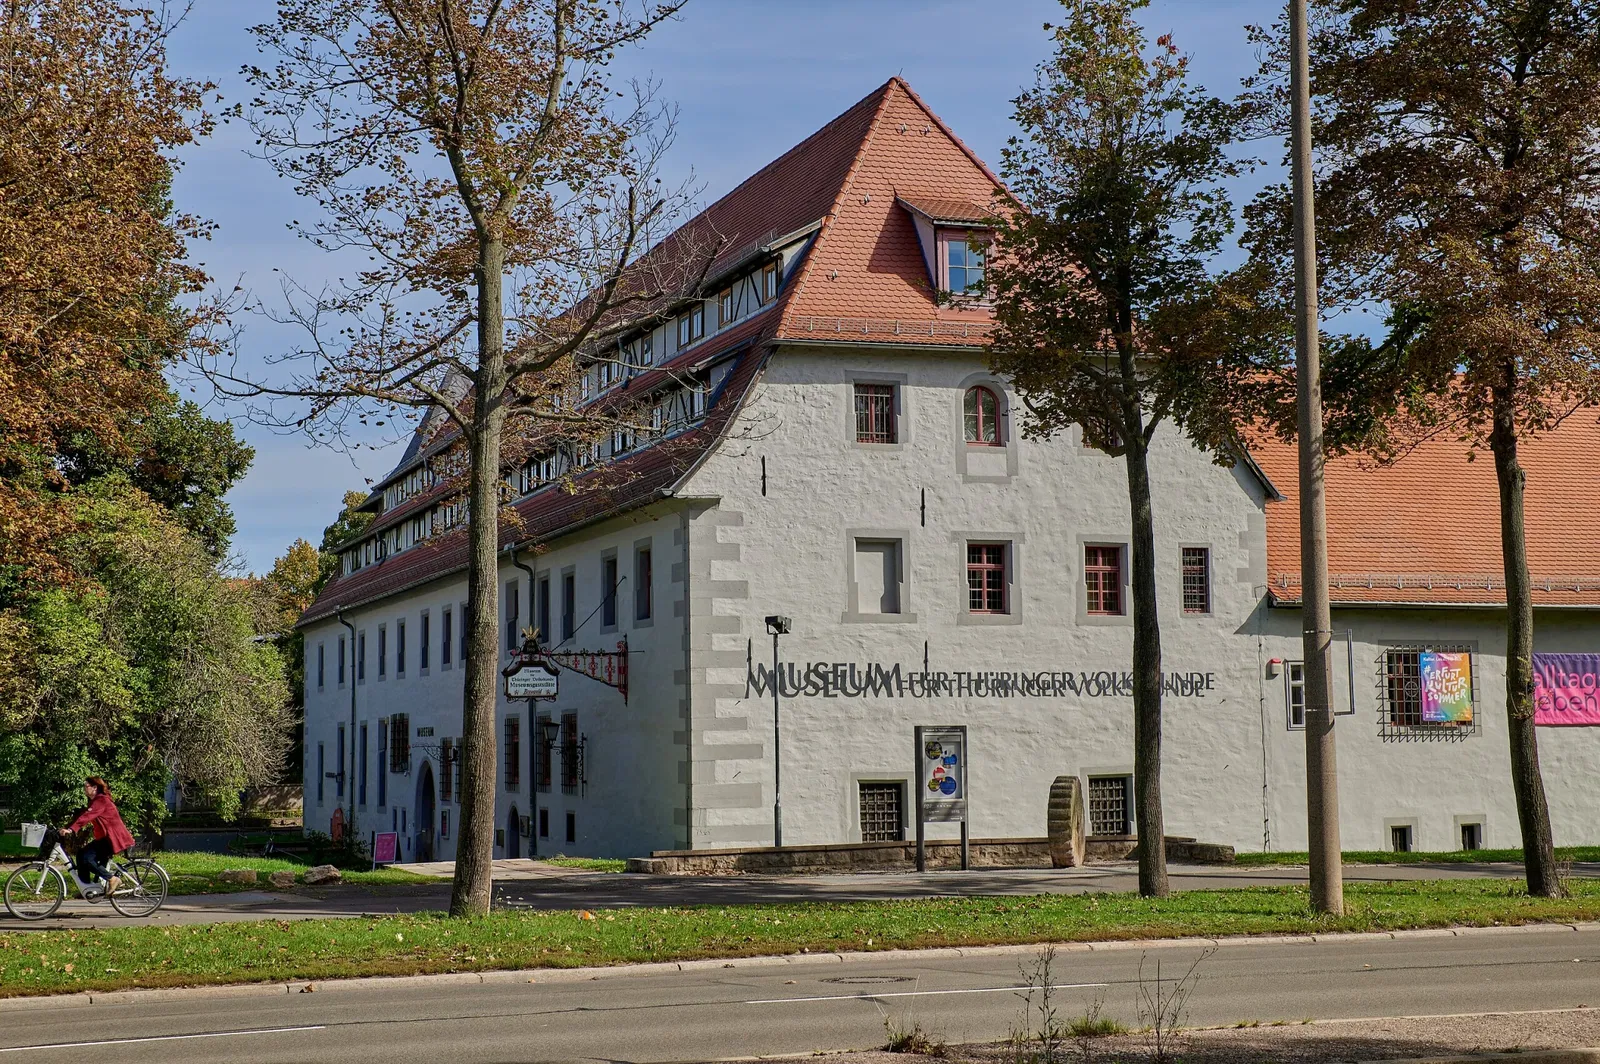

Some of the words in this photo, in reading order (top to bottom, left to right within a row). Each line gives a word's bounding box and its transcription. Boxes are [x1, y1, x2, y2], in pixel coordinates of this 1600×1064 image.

[756, 661, 901, 692] MUSEUM
[907, 671, 949, 692] FÜR
[952, 671, 1075, 692] THÜRINGER
[1425, 677, 1468, 693] KULTUR
[1534, 664, 1600, 696] alltag
[1427, 688, 1467, 704] SOMMER
